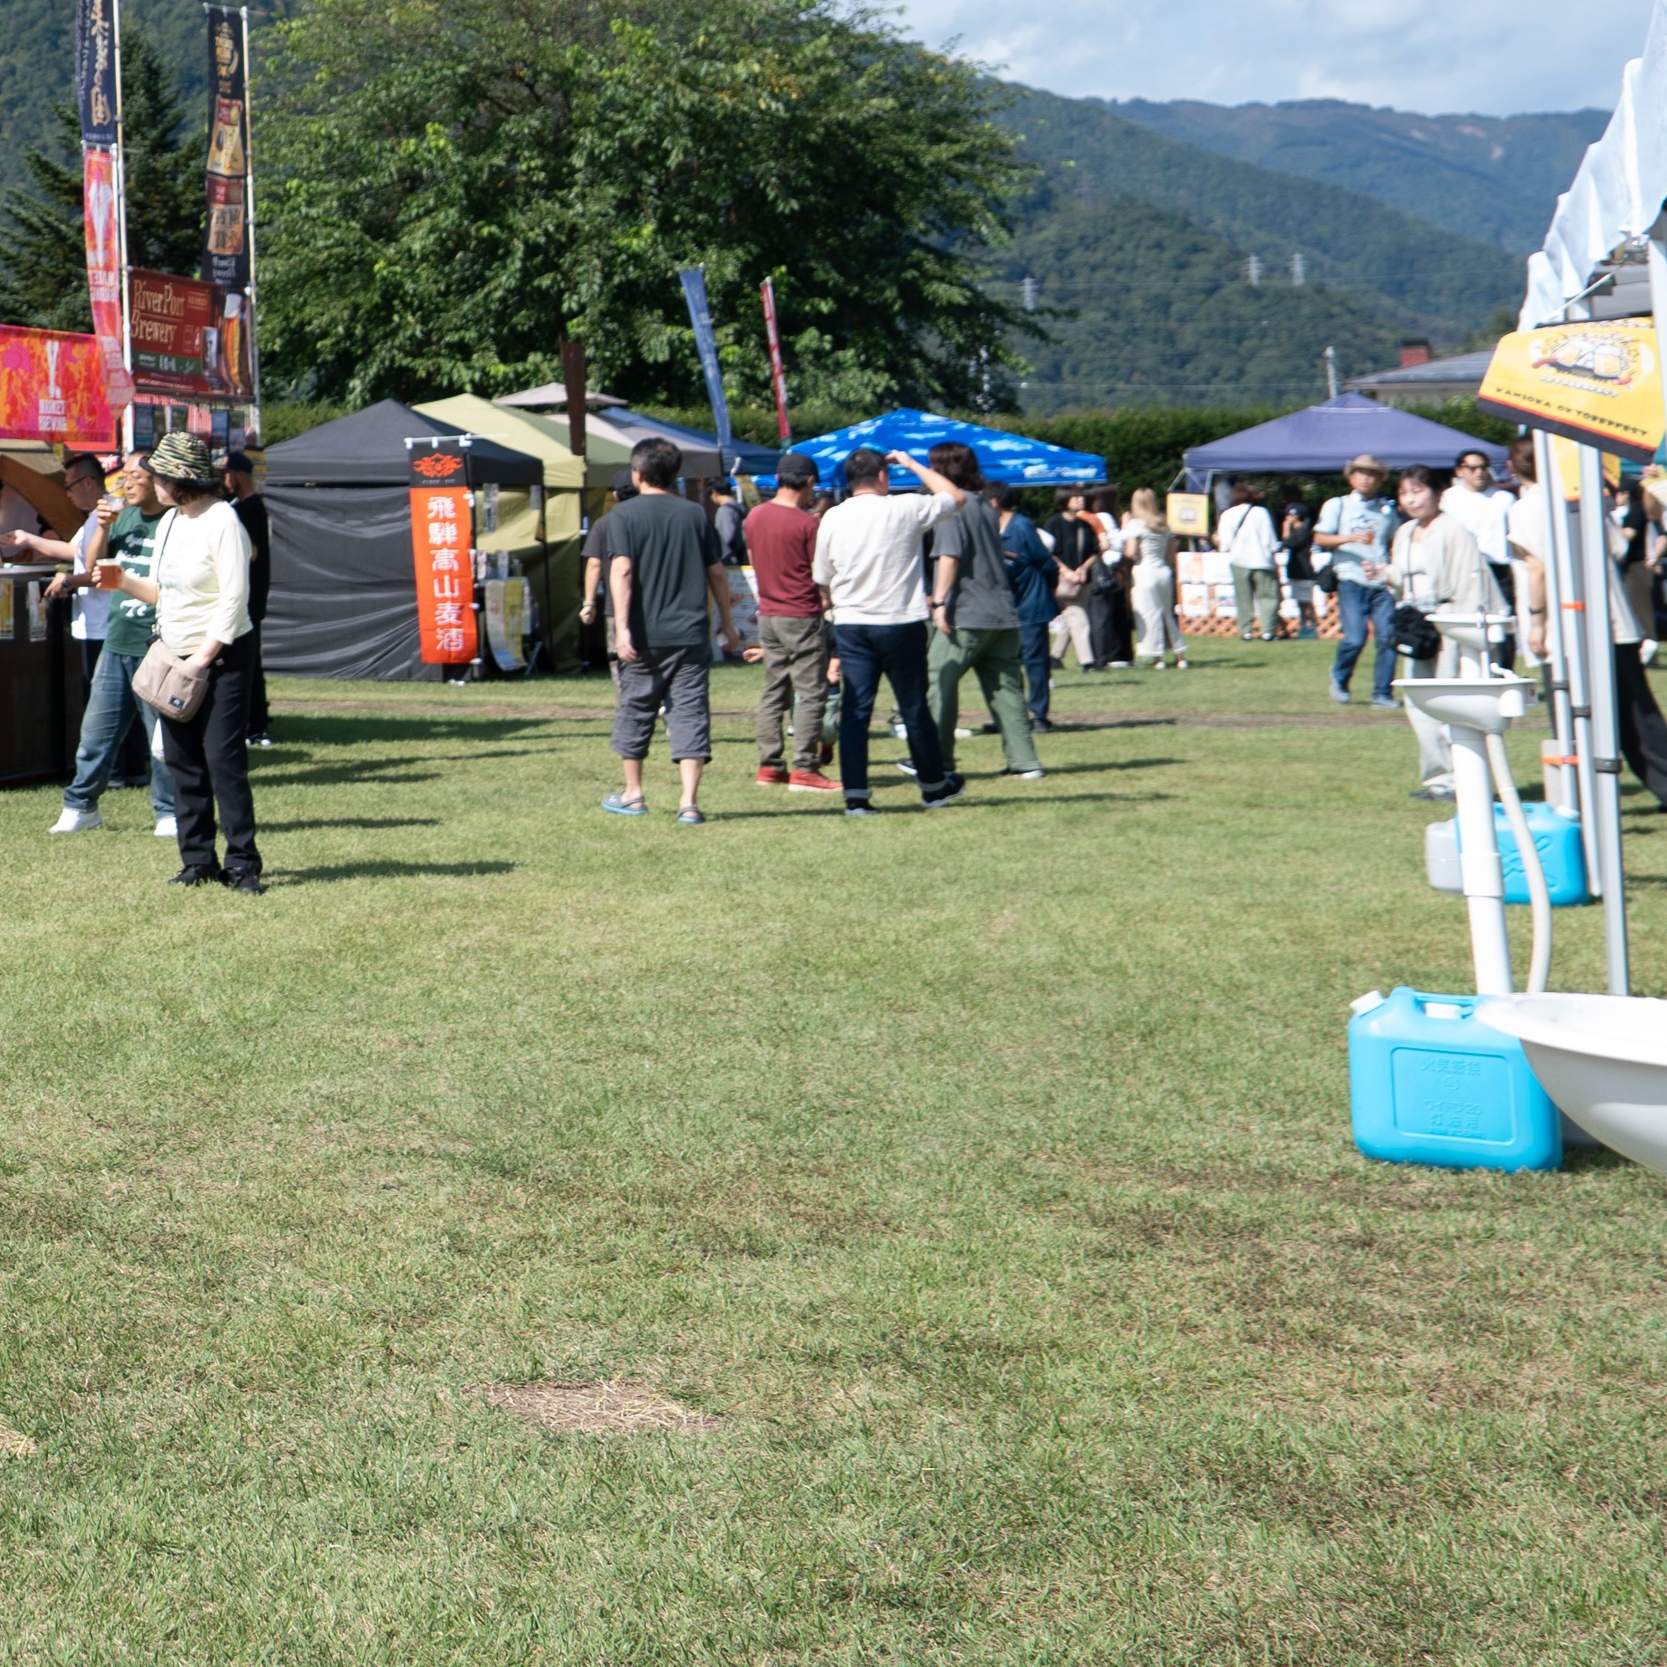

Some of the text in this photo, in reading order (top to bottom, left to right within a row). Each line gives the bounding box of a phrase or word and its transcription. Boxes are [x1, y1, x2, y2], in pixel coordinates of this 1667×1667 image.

[131, 308, 177, 351] Brewery
[1495, 387, 1551, 408] KAMIOKA
[427, 496, 465, 652] 飛騨高山麦酒
